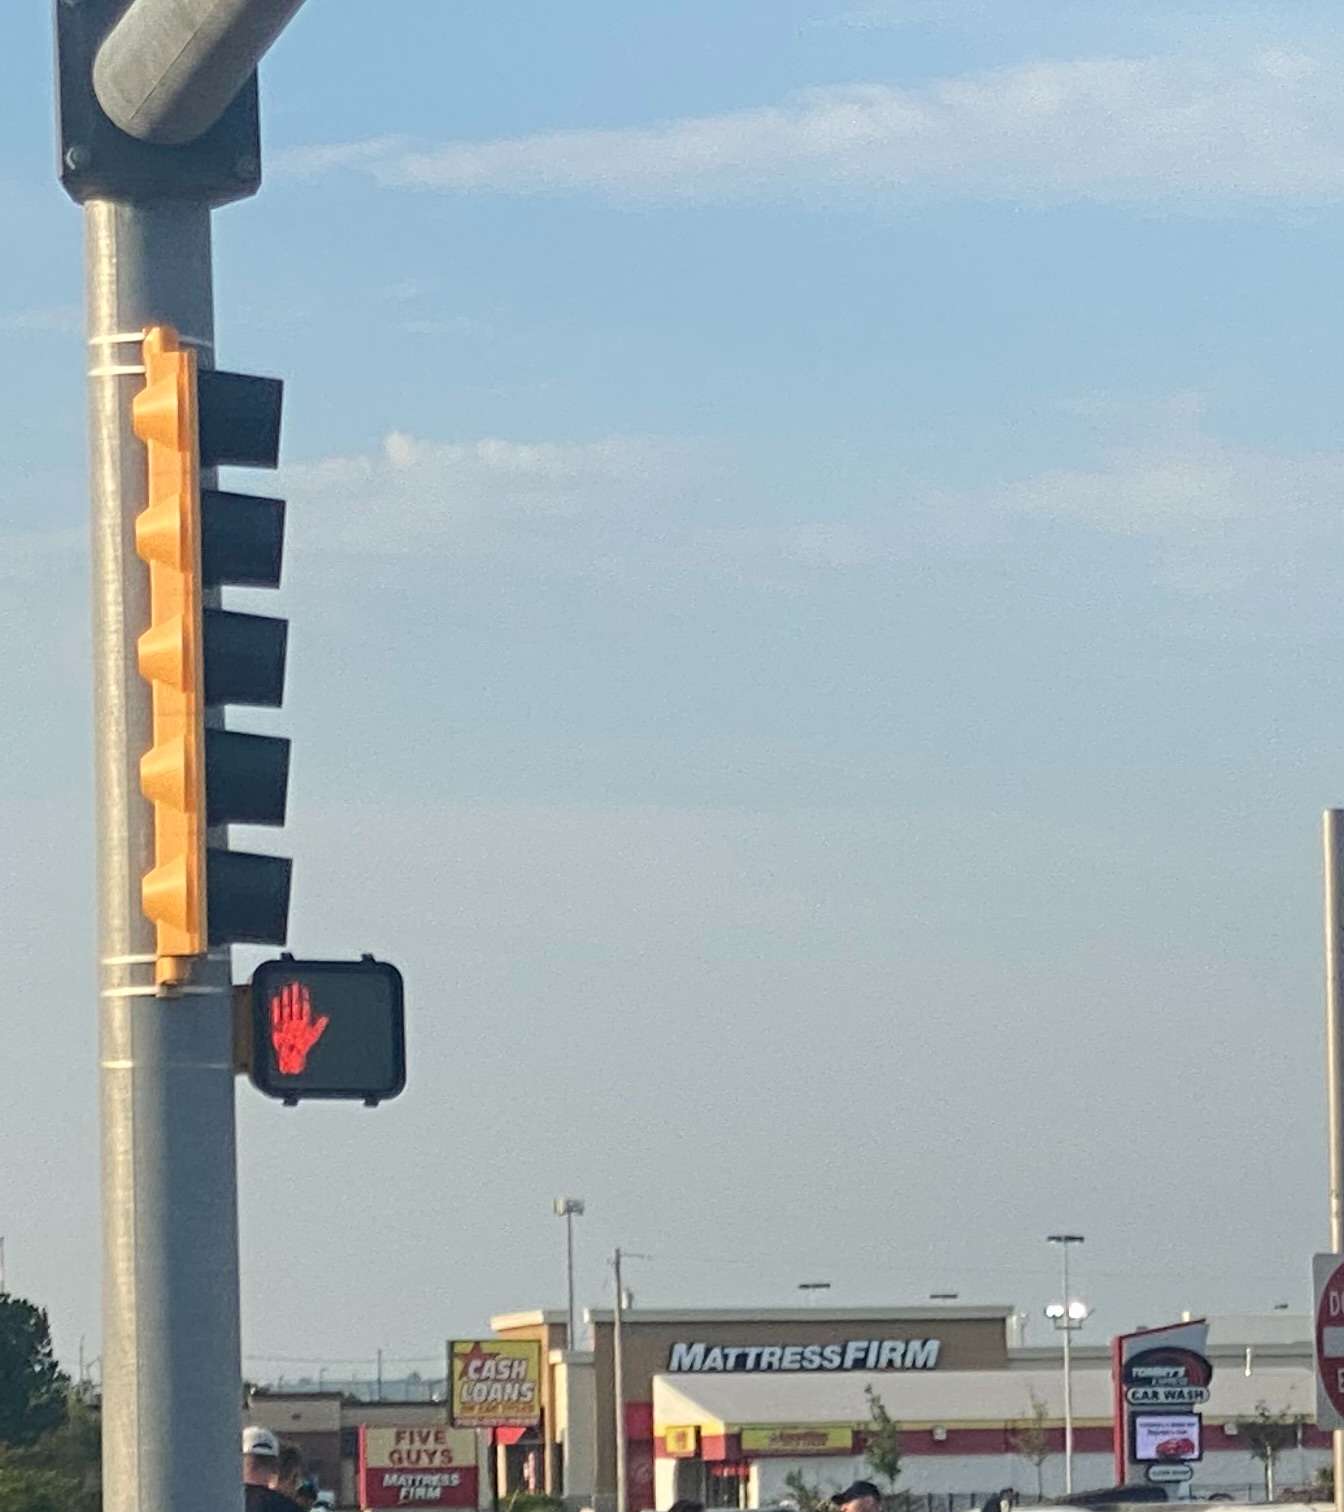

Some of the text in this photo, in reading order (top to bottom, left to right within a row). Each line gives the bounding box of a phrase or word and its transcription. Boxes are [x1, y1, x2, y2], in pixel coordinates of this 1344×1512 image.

[469, 1359, 526, 1380] CASH
[462, 1382, 534, 1403] LOANS
[1131, 1390, 1204, 1401] CAR WASH
[395, 1430, 447, 1445] FIVE
[388, 1449, 454, 1465] GUYS
[383, 1473, 460, 1487] MATTRESS
[400, 1487, 441, 1501] FIRM
